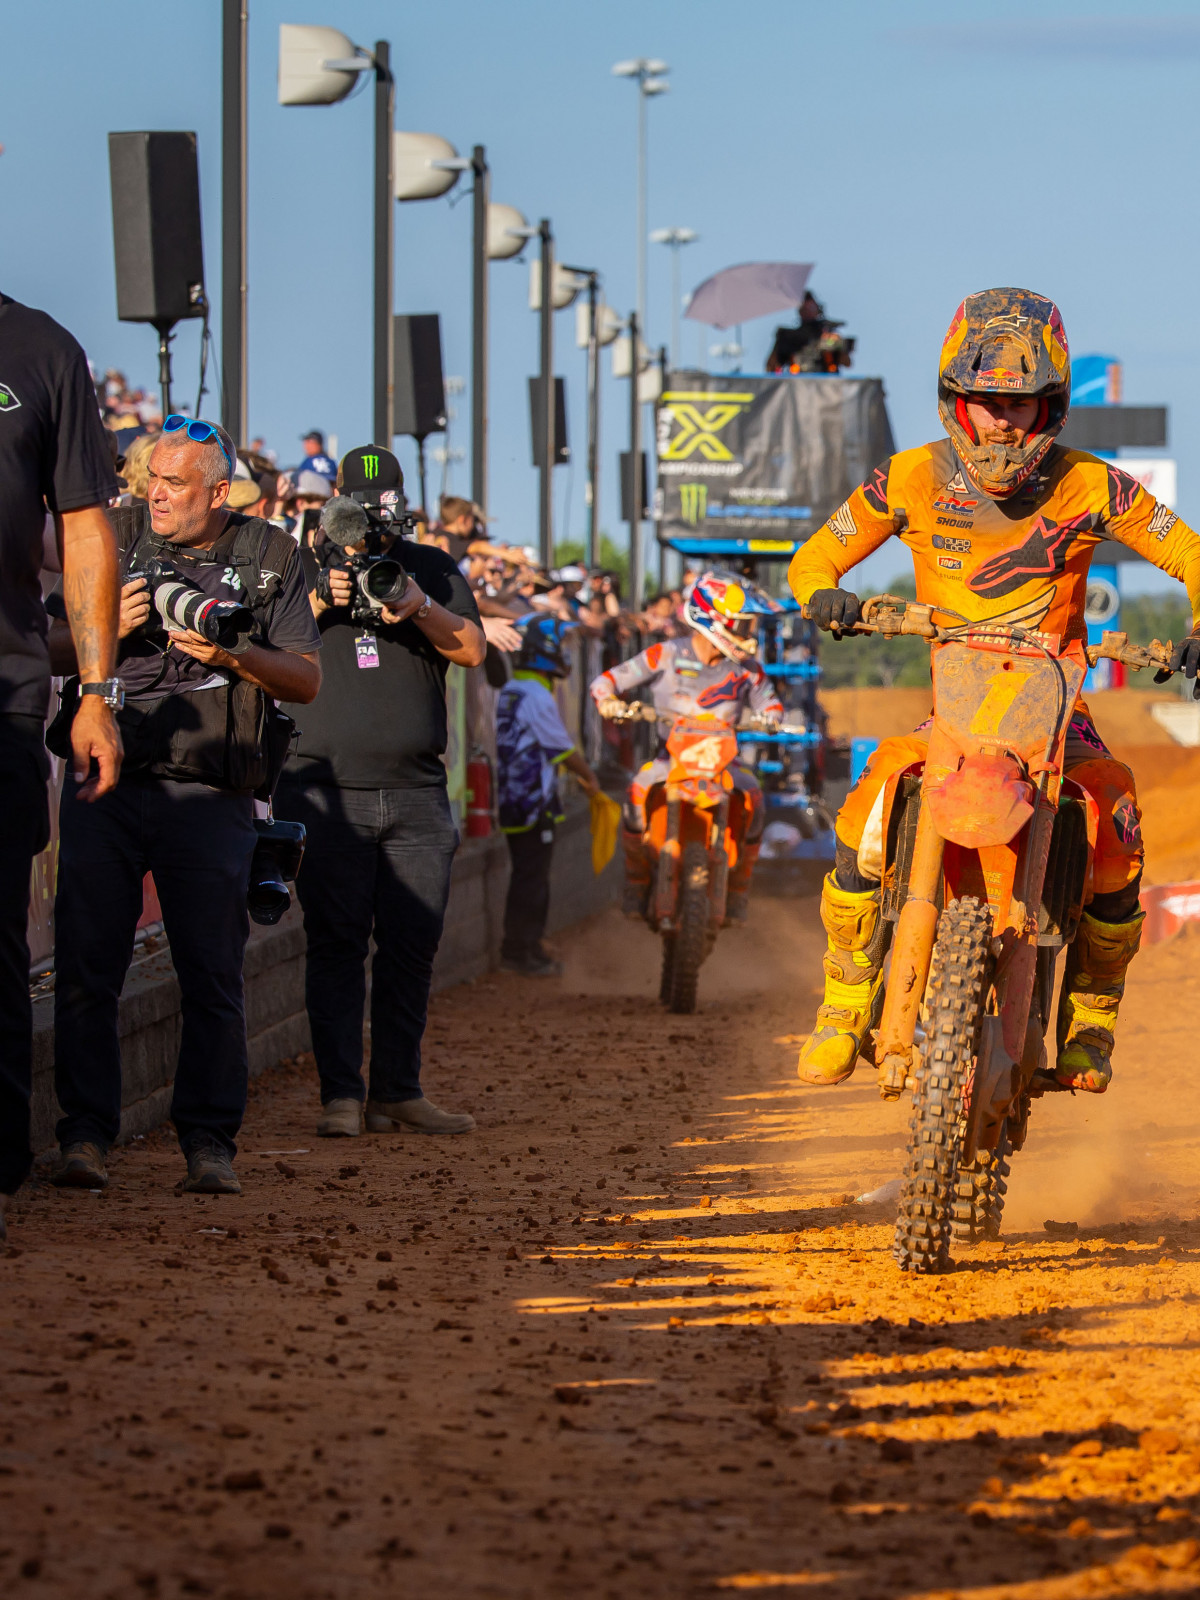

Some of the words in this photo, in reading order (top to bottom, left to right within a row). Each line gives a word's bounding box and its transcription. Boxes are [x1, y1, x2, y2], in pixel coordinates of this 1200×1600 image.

[976, 379, 998, 388] Red
[1000, 380, 1023, 389] Bull
[933, 496, 979, 514] HRC
[935, 517, 974, 530] SHOWA
[1156, 513, 1180, 542] HON
[826, 518, 848, 547] ONDA
[944, 544, 972, 554] LOCK
[945, 537, 971, 548] QUAD
[940, 558, 960, 569] 100%
[970, 672, 1032, 735] 1
